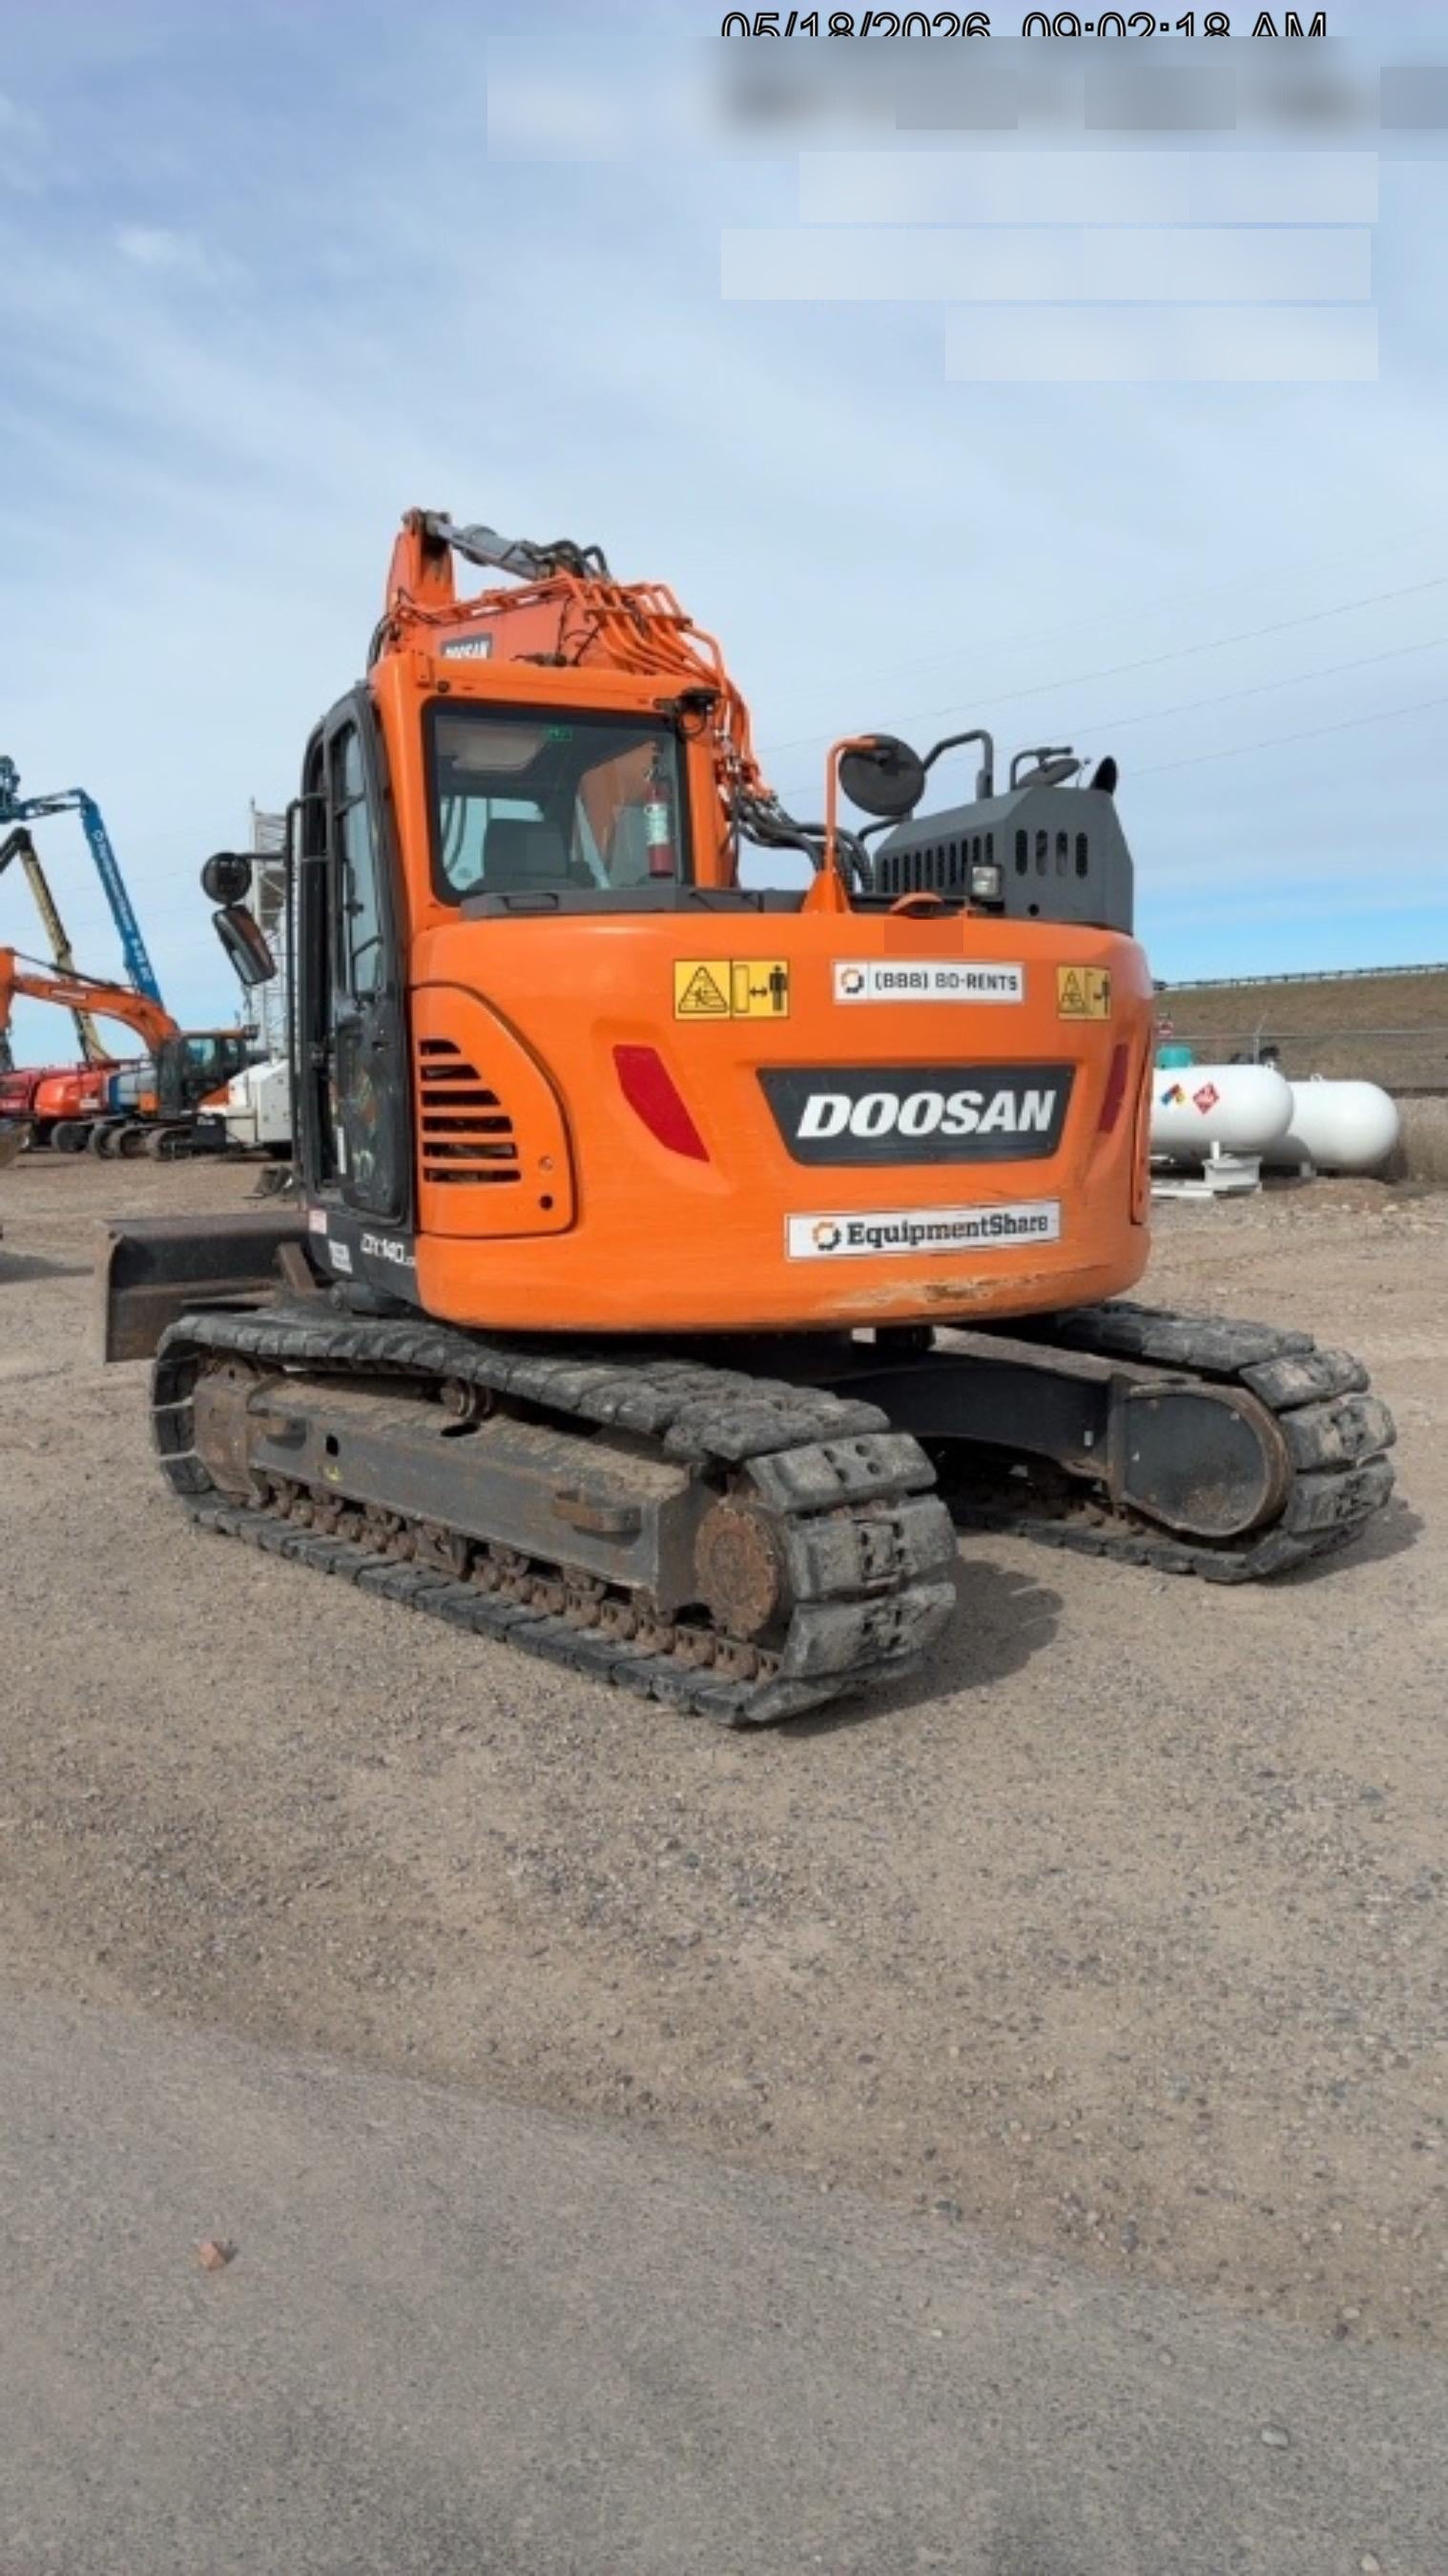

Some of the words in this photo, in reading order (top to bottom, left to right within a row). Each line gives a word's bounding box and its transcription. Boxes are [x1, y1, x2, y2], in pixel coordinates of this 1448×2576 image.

[875, 972, 928, 990] (888)
[796, 1090, 1057, 1138] DOOSAN
[846, 1213, 1048, 1249] EquipmentShare
